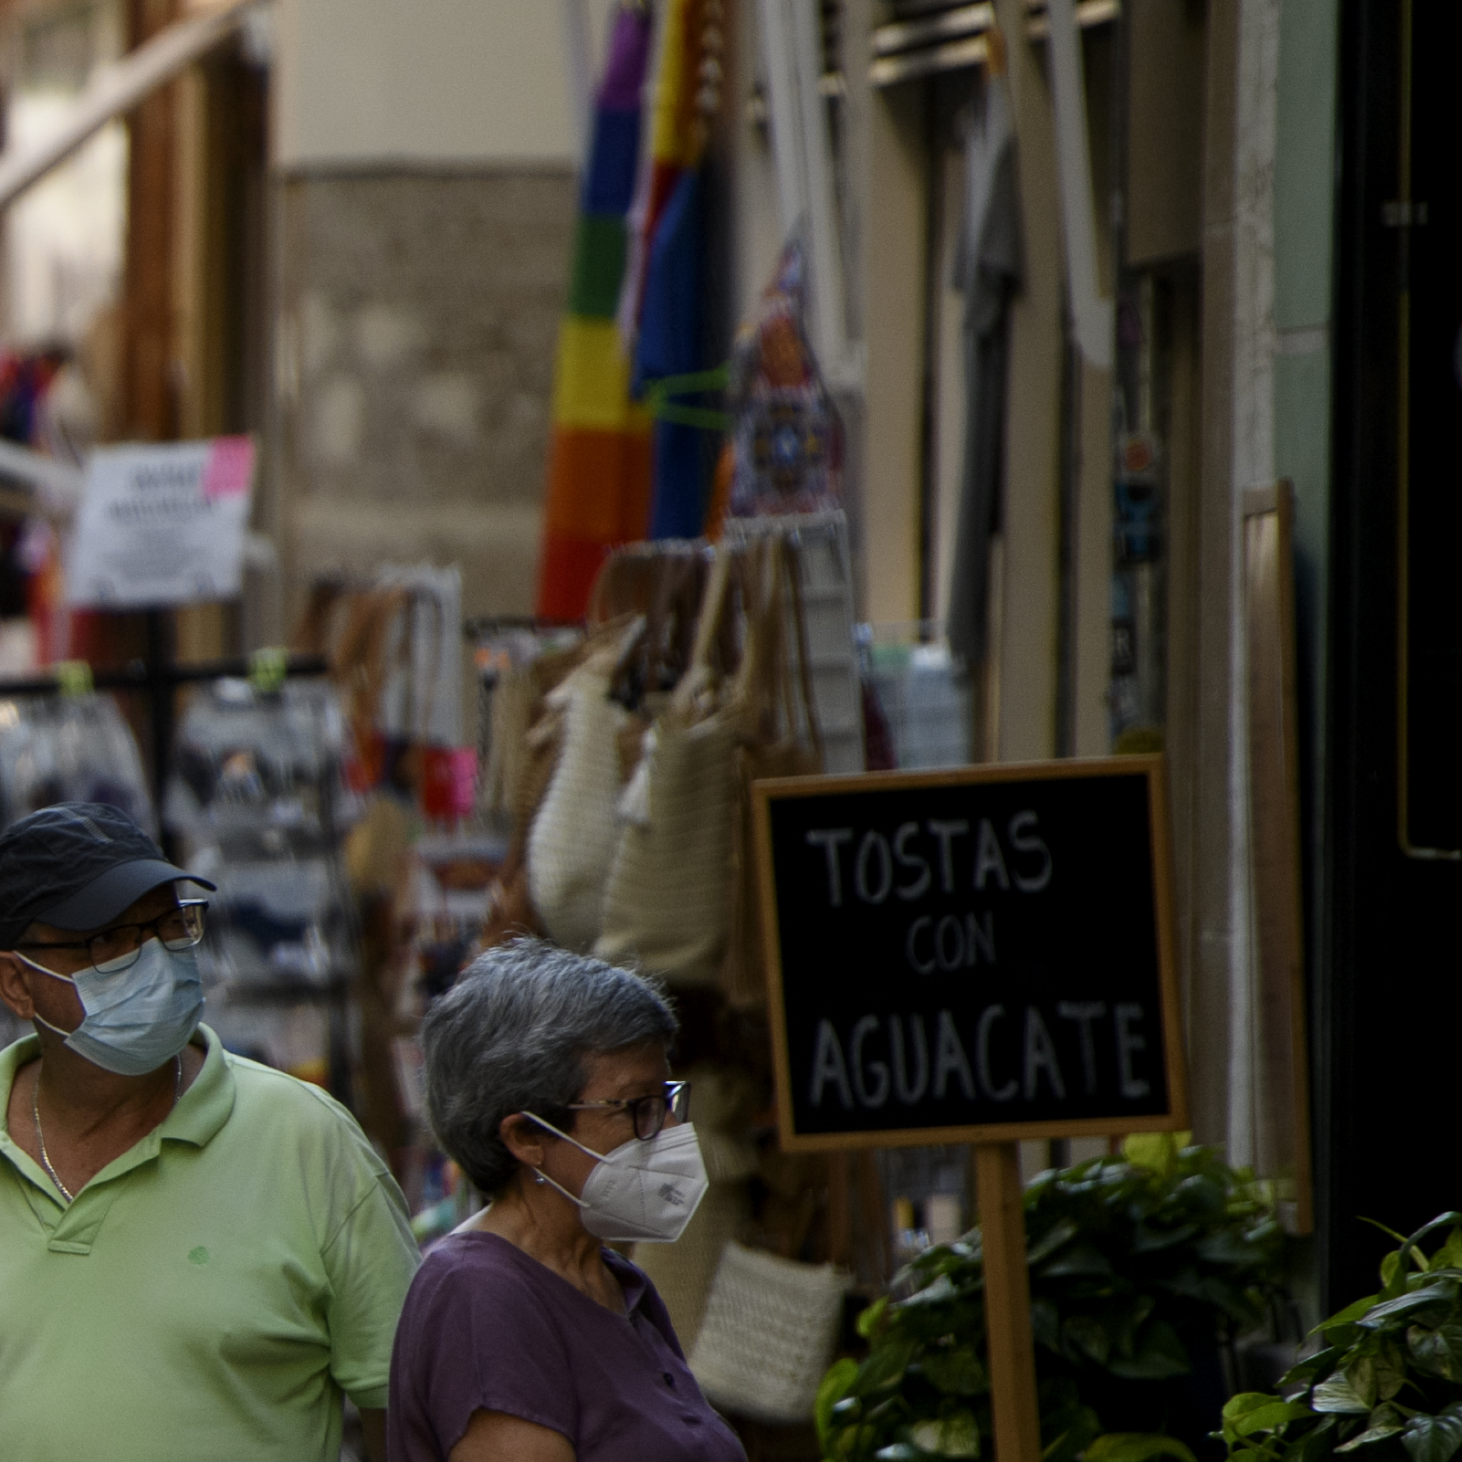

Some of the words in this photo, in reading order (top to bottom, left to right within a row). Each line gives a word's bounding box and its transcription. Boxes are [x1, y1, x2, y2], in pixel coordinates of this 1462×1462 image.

[805, 809, 1053, 907] TOSTAS
[904, 910, 999, 976] CON
[809, 1000, 1153, 1111] AGUACATE
